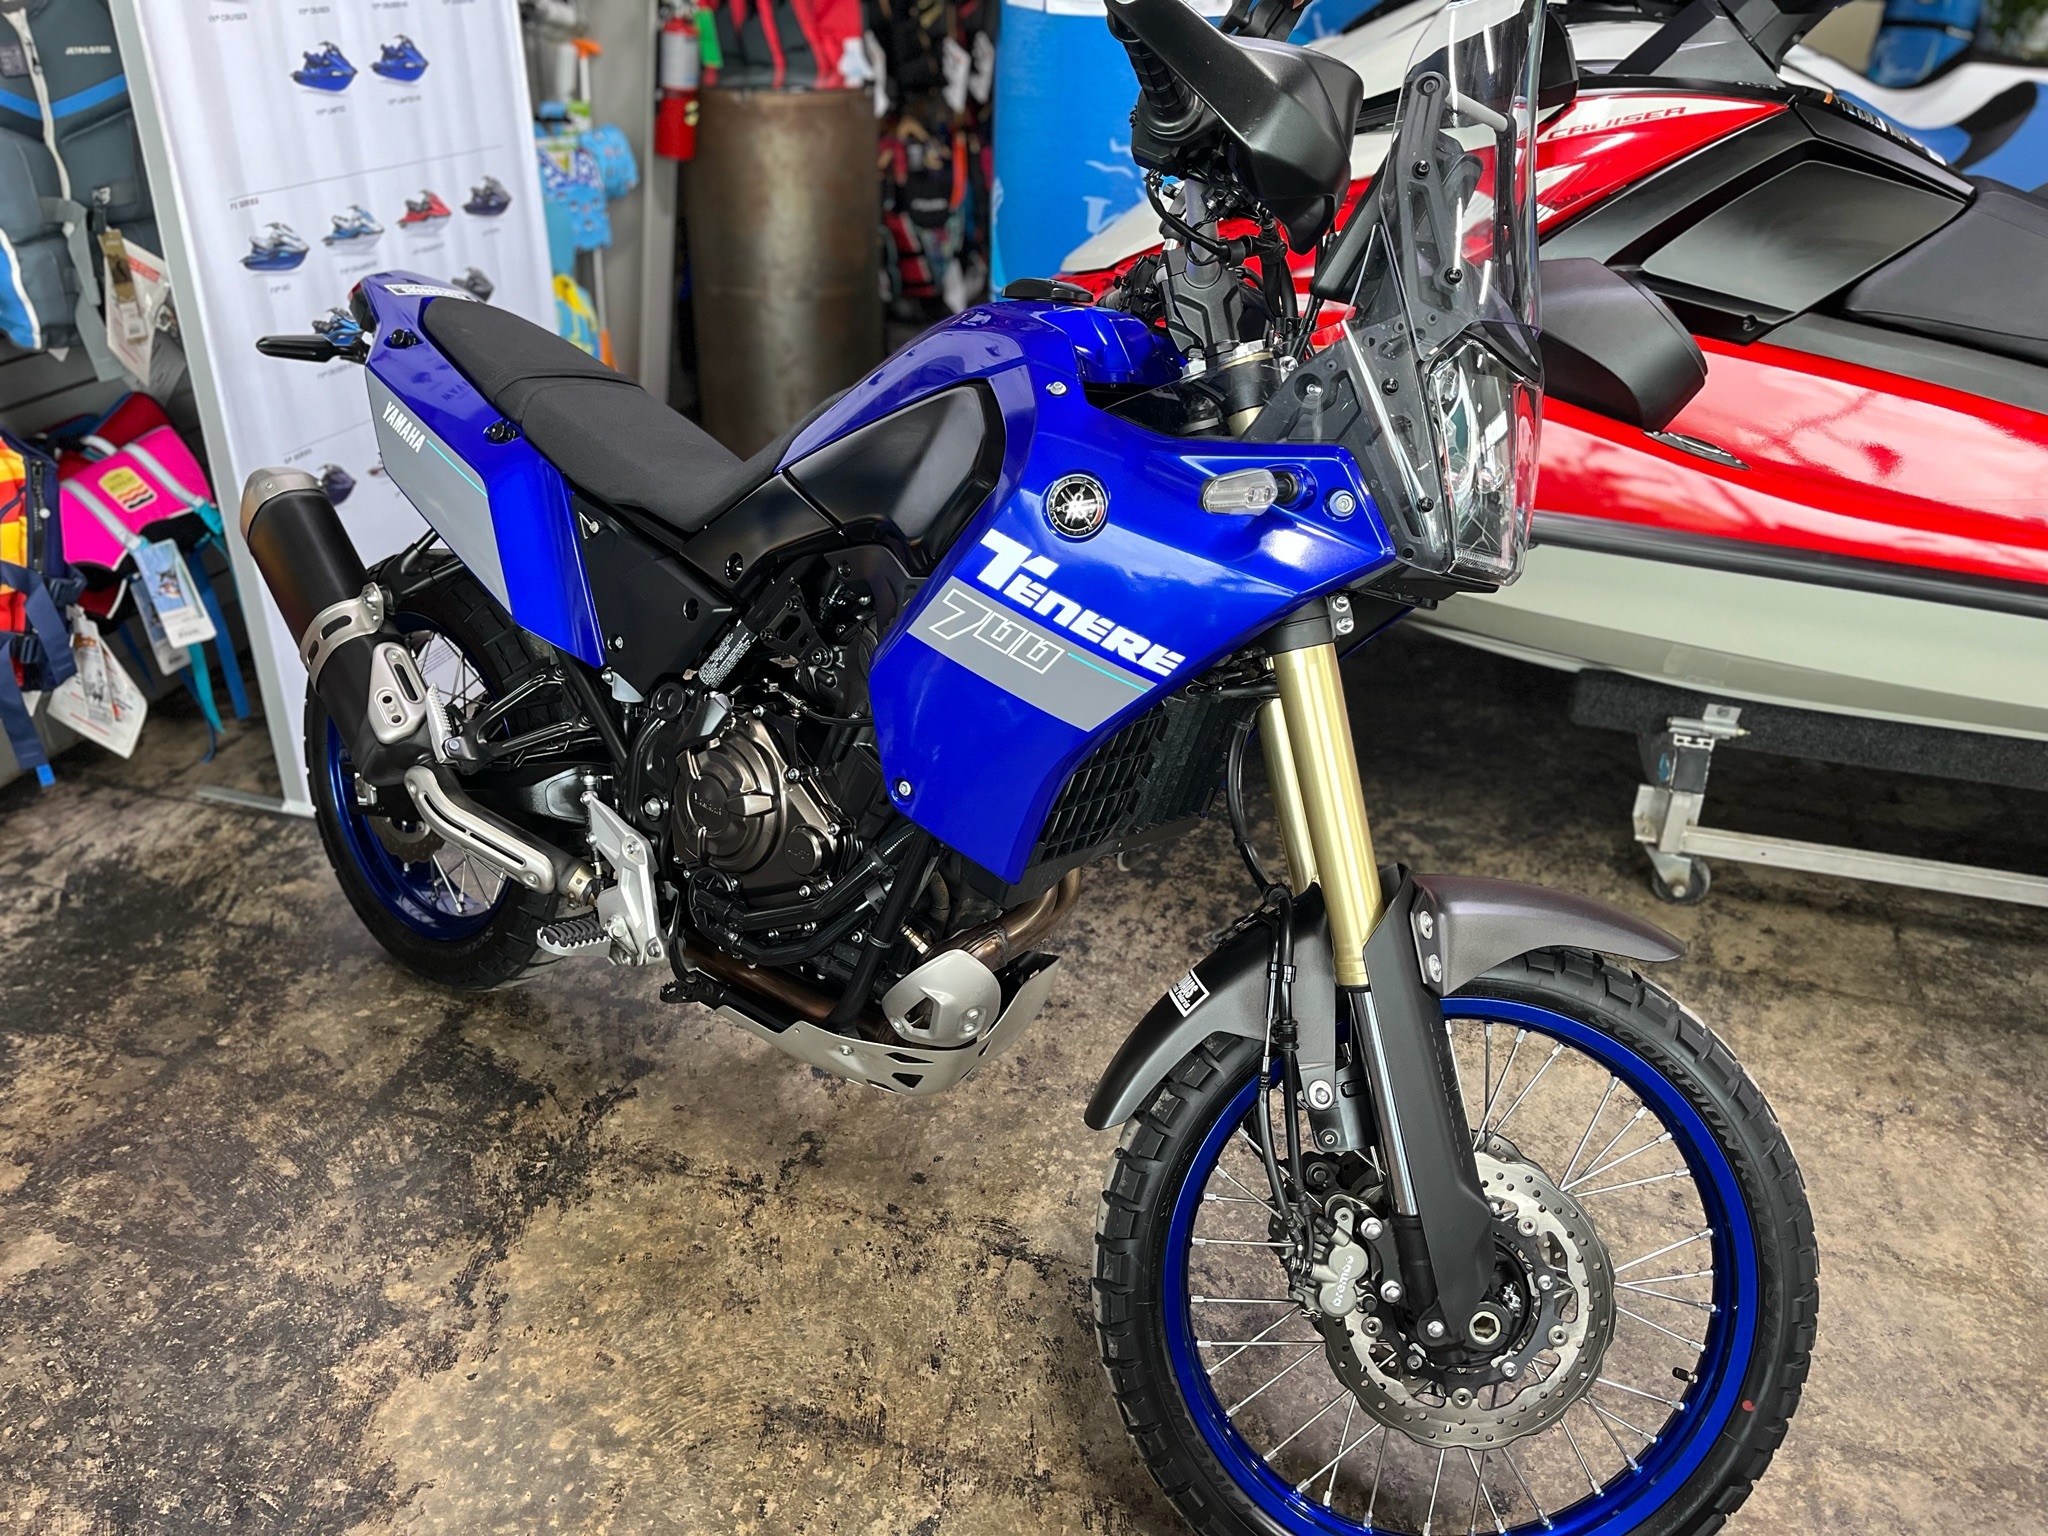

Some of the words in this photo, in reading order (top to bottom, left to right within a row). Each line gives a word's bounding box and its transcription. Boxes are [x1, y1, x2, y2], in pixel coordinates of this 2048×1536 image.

[1547, 106, 1687, 140] CRUISER
[382, 400, 426, 454] YAMAHA
[928, 588, 1065, 674] 700
[1587, 1013, 1742, 1151] SCORPION
[1332, 1254, 1354, 1307] brembo
